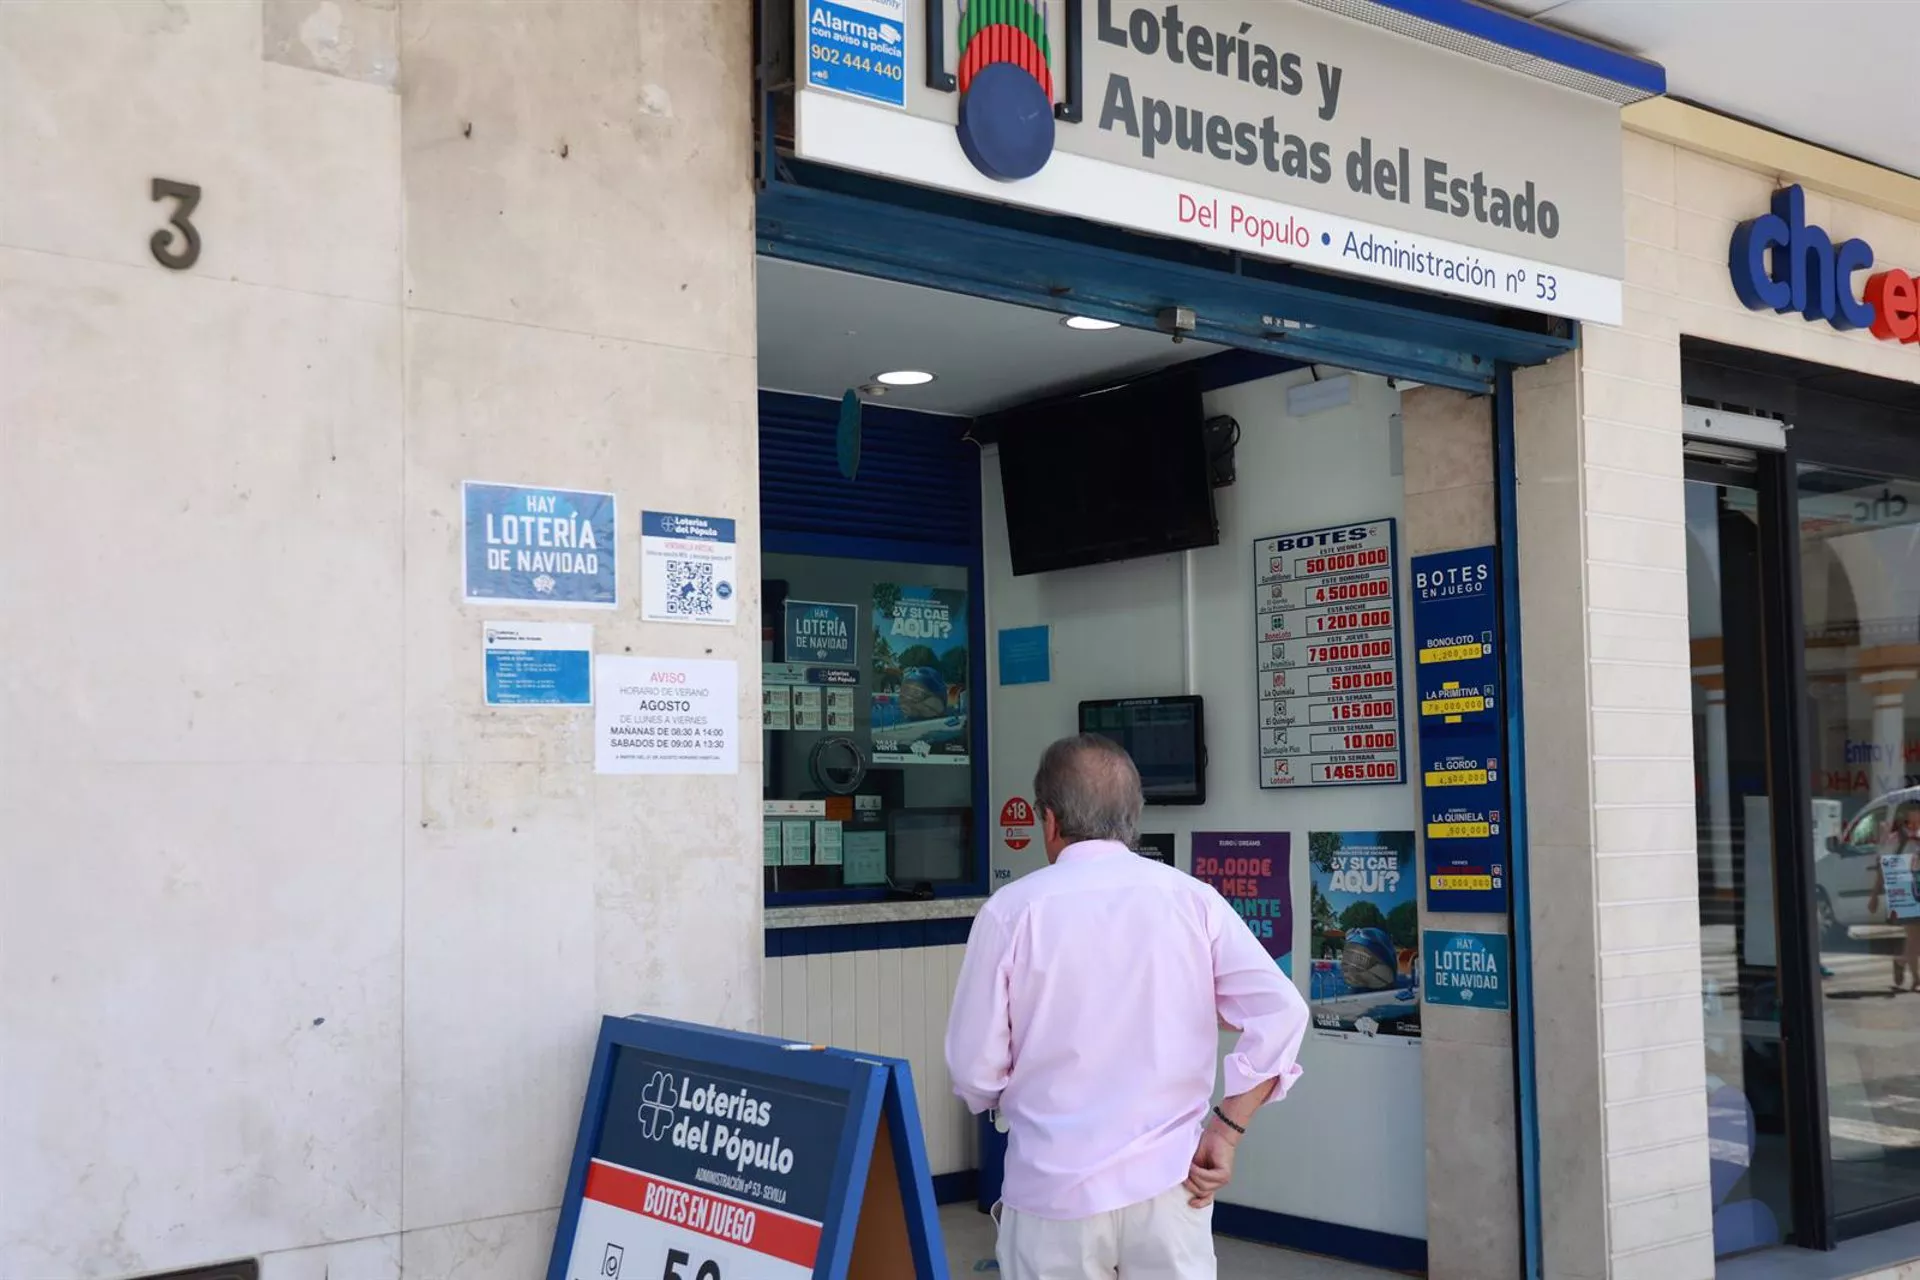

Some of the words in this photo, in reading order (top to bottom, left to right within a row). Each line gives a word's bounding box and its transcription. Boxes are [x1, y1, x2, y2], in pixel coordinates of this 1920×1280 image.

[811, 7, 878, 41] Alarma
[811, 26, 831, 39] con
[833, 33, 860, 46] aviso
[862, 41, 868, 49] a
[811, 44, 840, 65] 902
[842, 53, 871, 73] 444
[874, 61, 902, 81] 440
[1097, 0, 1303, 96] Loterías
[1316, 62, 1343, 121] y
[1099, 73, 1332, 184] Apuestas
[1346, 137, 1410, 204] del
[1424, 157, 1560, 240] Estado
[150, 178, 202, 270] 3
[1178, 193, 1218, 230] Del
[1230, 205, 1310, 249] Populo
[1342, 231, 1496, 289] Administración
[1536, 273, 1558, 302] 53
[527, 495, 556, 513] HAY
[486, 510, 598, 549] LOTERÍA
[1277, 527, 1368, 552] BOTES
[1337, 543, 1363, 552] VIERNES
[488, 549, 512, 571] DE
[517, 550, 599, 574] NAVIDAD
[1339, 573, 1370, 583] DOMINGO
[1416, 564, 1488, 589] BOTES
[1422, 588, 1437, 598] EN
[1441, 583, 1483, 596] JUEGO
[814, 608, 829, 619] HAY
[893, 606, 908, 617] ¿Y
[910, 607, 921, 618] SI
[924, 609, 949, 620] CAE
[1345, 603, 1366, 612] NOCHE
[795, 617, 847, 637] LOTERÍA
[796, 636, 807, 648] DE
[809, 637, 848, 650] NAVIDAD
[1427, 635, 1474, 648] BONOLOTO
[1344, 664, 1372, 672] SEMANA
[650, 672, 687, 684] AVISO
[620, 687, 659, 696] HORARIO
[661, 688, 673, 696] DE
[675, 688, 709, 697] VERANO
[1426, 691, 1437, 699] LA
[1438, 687, 1480, 698] PRIMITIVA
[639, 700, 691, 712] AGOSTO
[620, 715, 632, 724] DE
[634, 715, 662, 724] LUNES
[664, 716, 671, 724] A
[672, 716, 708, 725] VIERNES
[610, 725, 655, 736] MAÑANAS
[657, 727, 669, 736] DE
[695, 728, 700, 736] A
[703, 729, 724, 737] 14:00
[656, 739, 669, 748] DE
[671, 740, 693, 748] 09:00
[695, 740, 700, 748] A
[1434, 762, 1445, 770] EL
[1446, 760, 1478, 770] GORDO
[1006, 802, 1027, 820] +18
[1433, 813, 1444, 822] LA
[1444, 812, 1484, 822] QUINIELA
[1195, 856, 1273, 877] 20.000€
[1331, 856, 1348, 870] ¿Y
[1350, 857, 1364, 870] SI
[1367, 857, 1398, 870] CAE
[994, 869, 1011, 879] VISA
[1222, 877, 1258, 898] MES
[1456, 938, 1474, 949] HAY
[1434, 947, 1498, 972] LOTERÍA
[1435, 972, 1449, 986] DE
[1451, 973, 1498, 989] NAVIDAD
[679, 1077, 773, 1128] Loterias
[672, 1115, 709, 1155] del
[712, 1123, 795, 1175] Pópulo
[695, 1167, 745, 1192] ADMINISTRACIÓN
[643, 1182, 689, 1226] BOTES
[686, 1196, 709, 1230] EN
[703, 1199, 756, 1244] JUEGO
